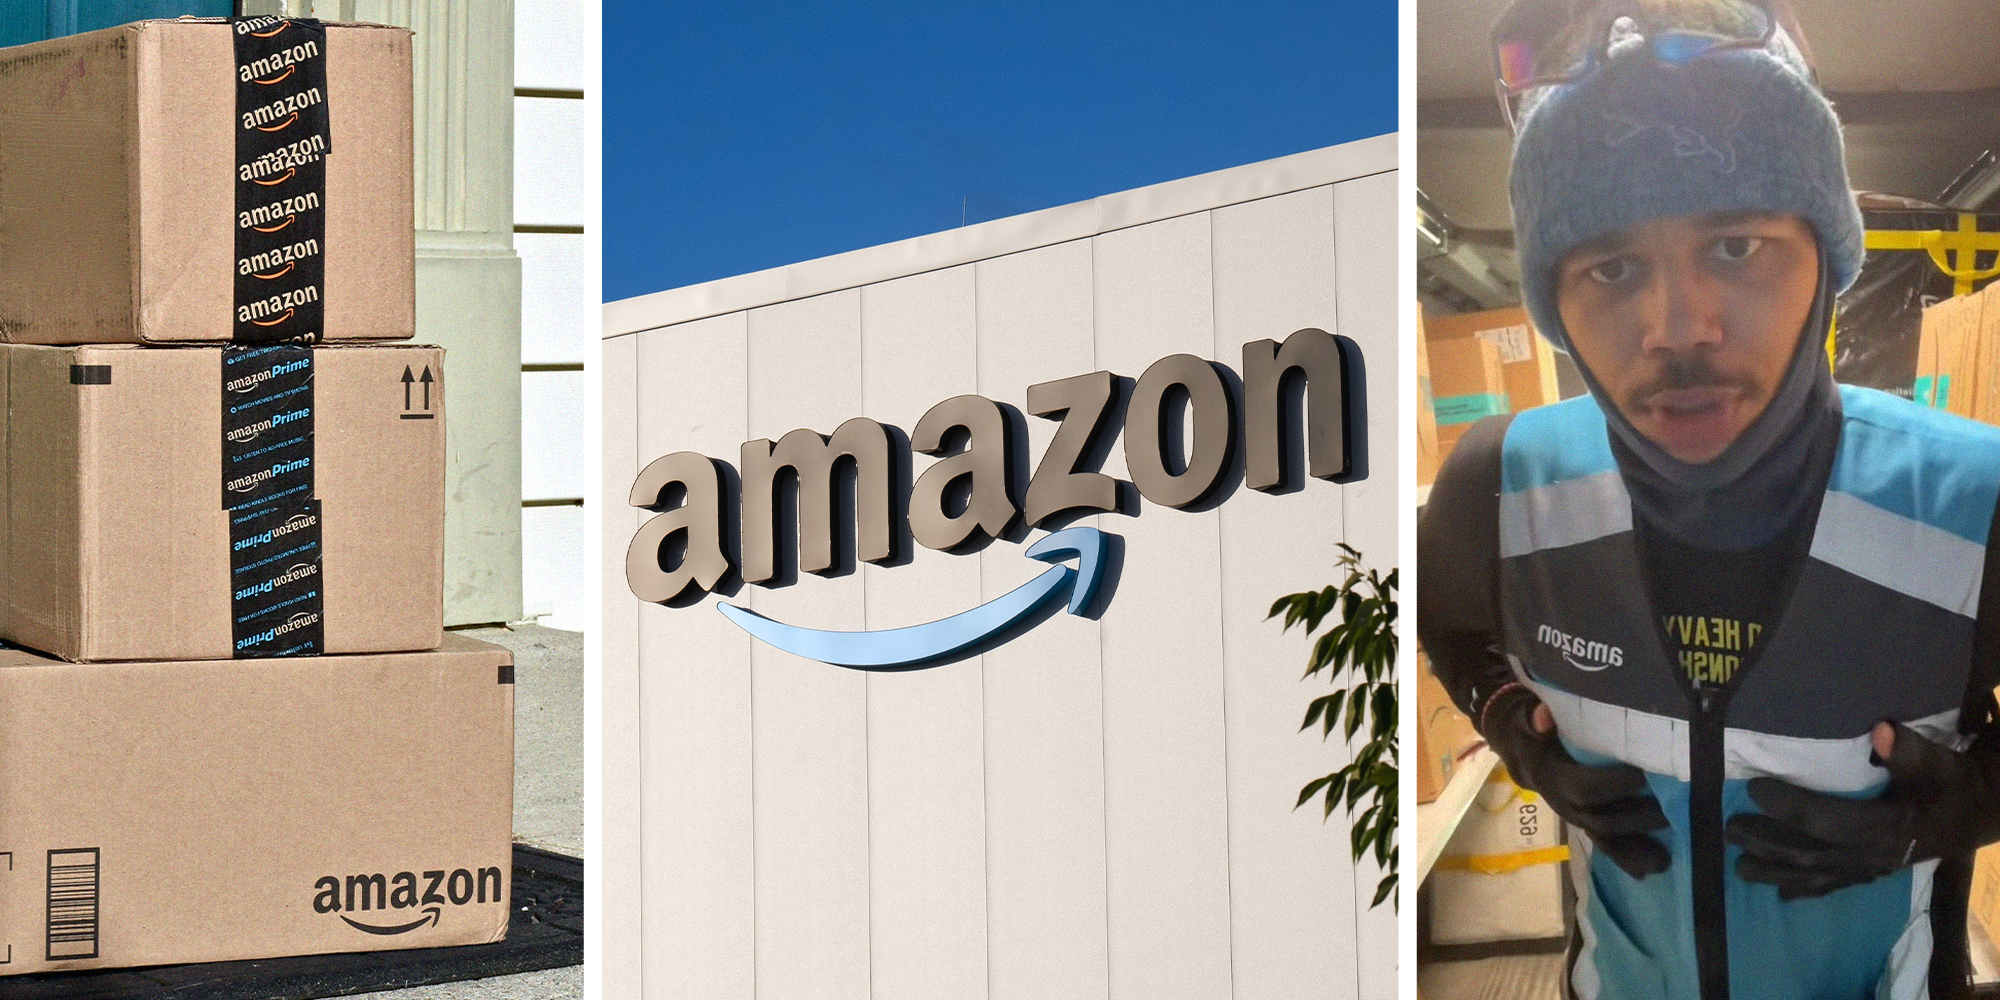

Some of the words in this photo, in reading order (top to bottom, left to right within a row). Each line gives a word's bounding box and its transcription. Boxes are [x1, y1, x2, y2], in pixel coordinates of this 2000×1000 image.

[239, 40, 319, 82] amazon
[242, 87, 322, 130] amazon
[238, 191, 320, 229] amazon
[238, 238, 319, 276] amazon
[237, 285, 319, 323] amazon
[625, 327, 1352, 608] amazon
[313, 866, 502, 914] amazon
